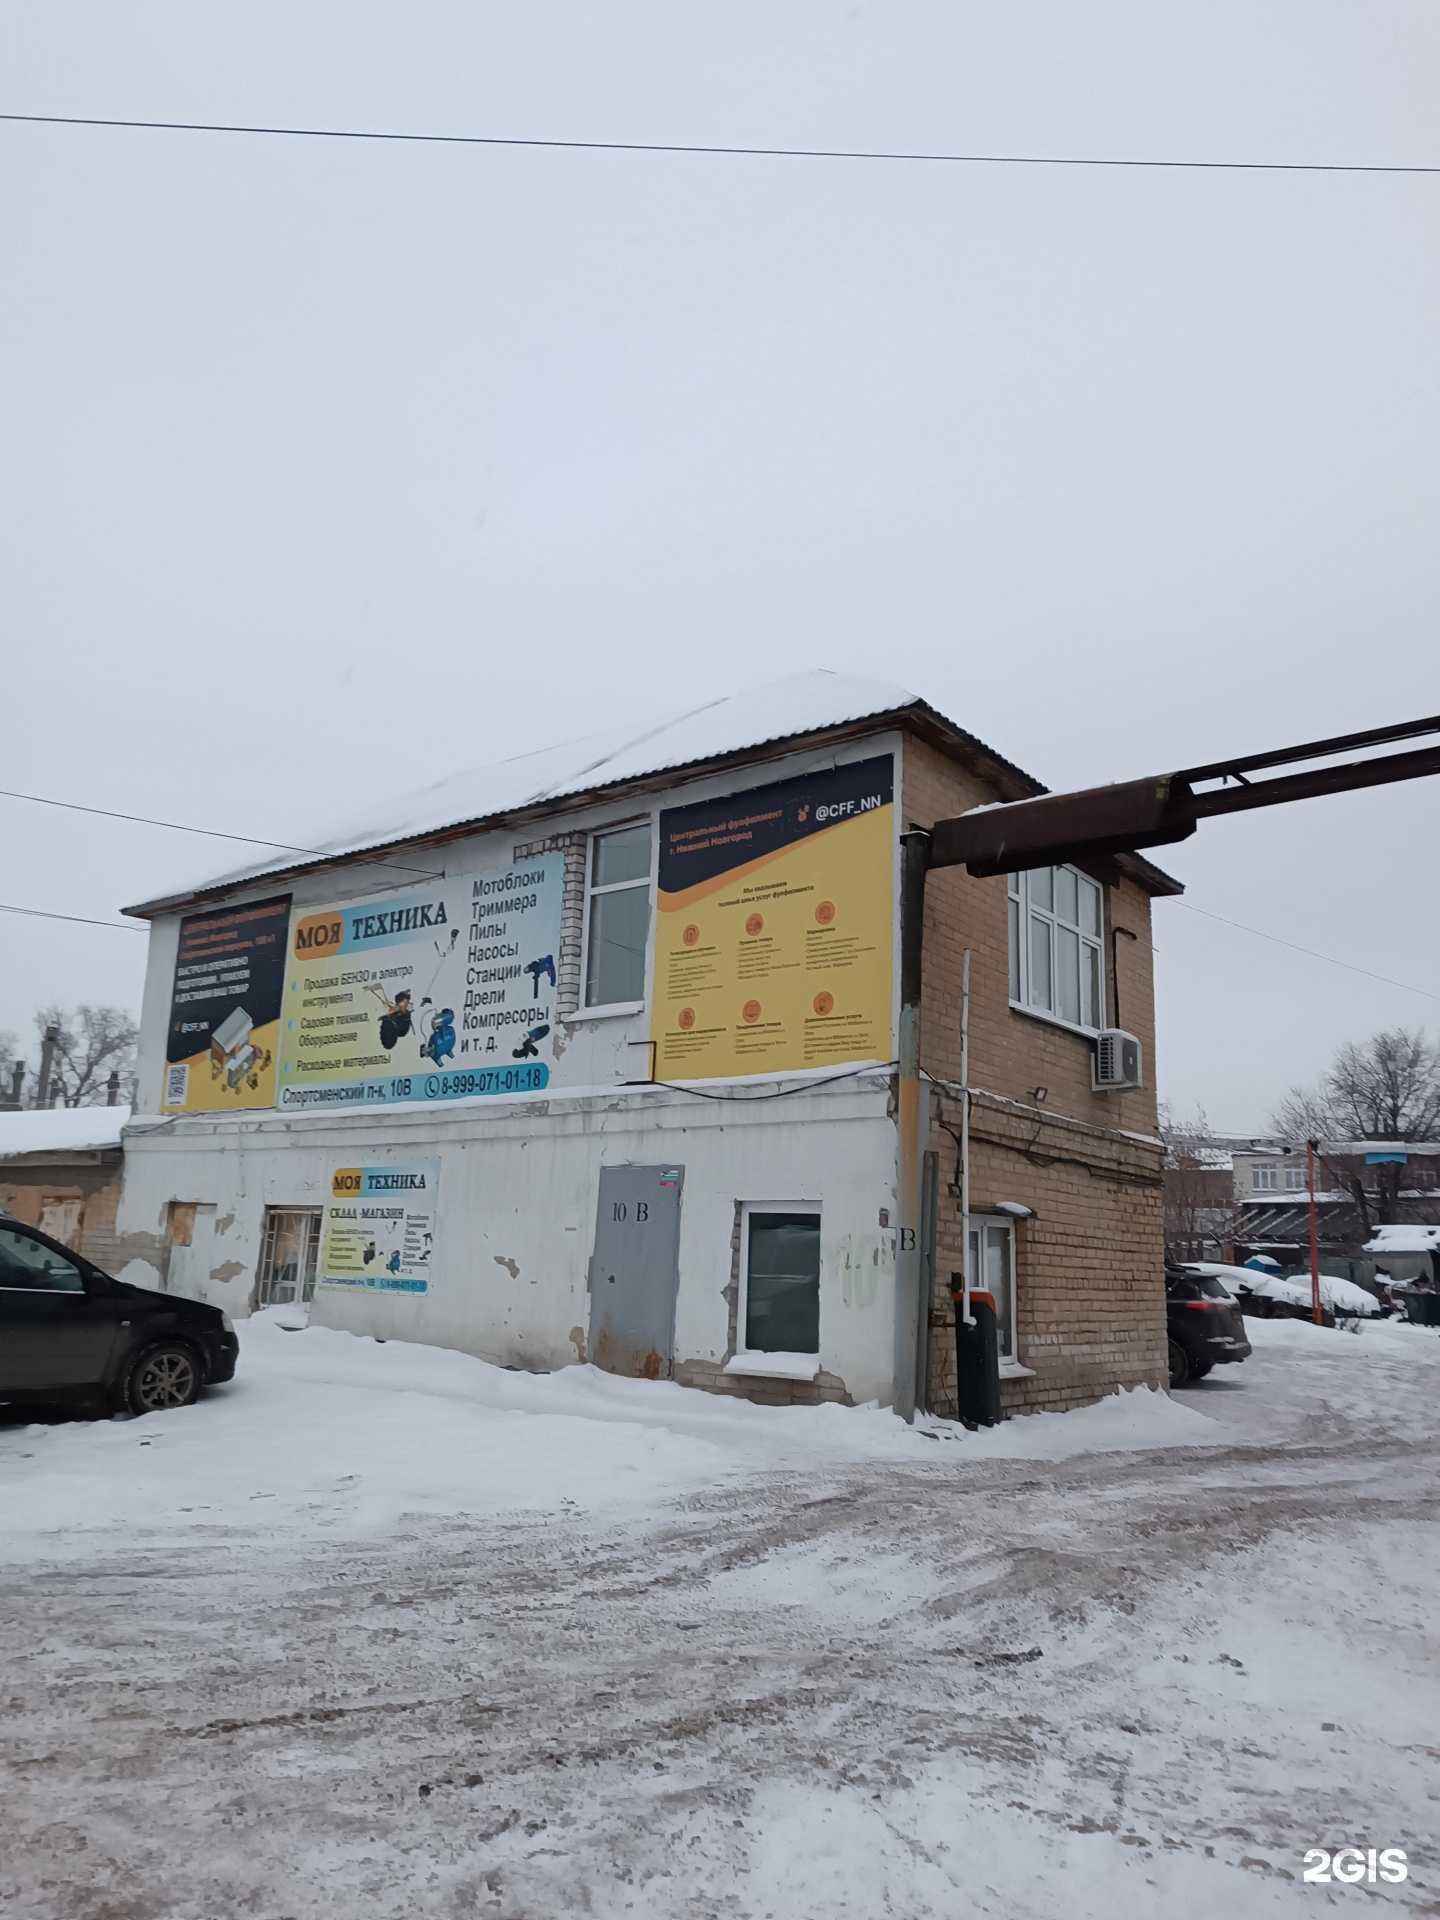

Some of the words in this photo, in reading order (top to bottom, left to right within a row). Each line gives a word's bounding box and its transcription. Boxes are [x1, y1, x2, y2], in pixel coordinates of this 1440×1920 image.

[814, 795, 882, 821] @CFF_NN
[472, 870, 545, 898] Мотоблоки
[472, 894, 537, 923] Триммера
[295, 922, 342, 950] МОЯ
[352, 901, 448, 941] ТЕХНИКА
[469, 922, 507, 942] Пилы
[467, 942, 519, 963] Насосы
[466, 964, 522, 985] Станции
[463, 989, 505, 1011] Дрели
[462, 1006, 549, 1031] Компресоры
[460, 1039, 469, 1053] и
[283, 1083, 365, 1107] Спортсменский
[390, 1078, 412, 1097] 10В
[441, 1068, 541, 1095] 8-999-071-01-18
[332, 1175, 361, 1190] МОЯ
[367, 1174, 426, 1190] ТЕХНИКА
[613, 1202, 627, 1222] 10
